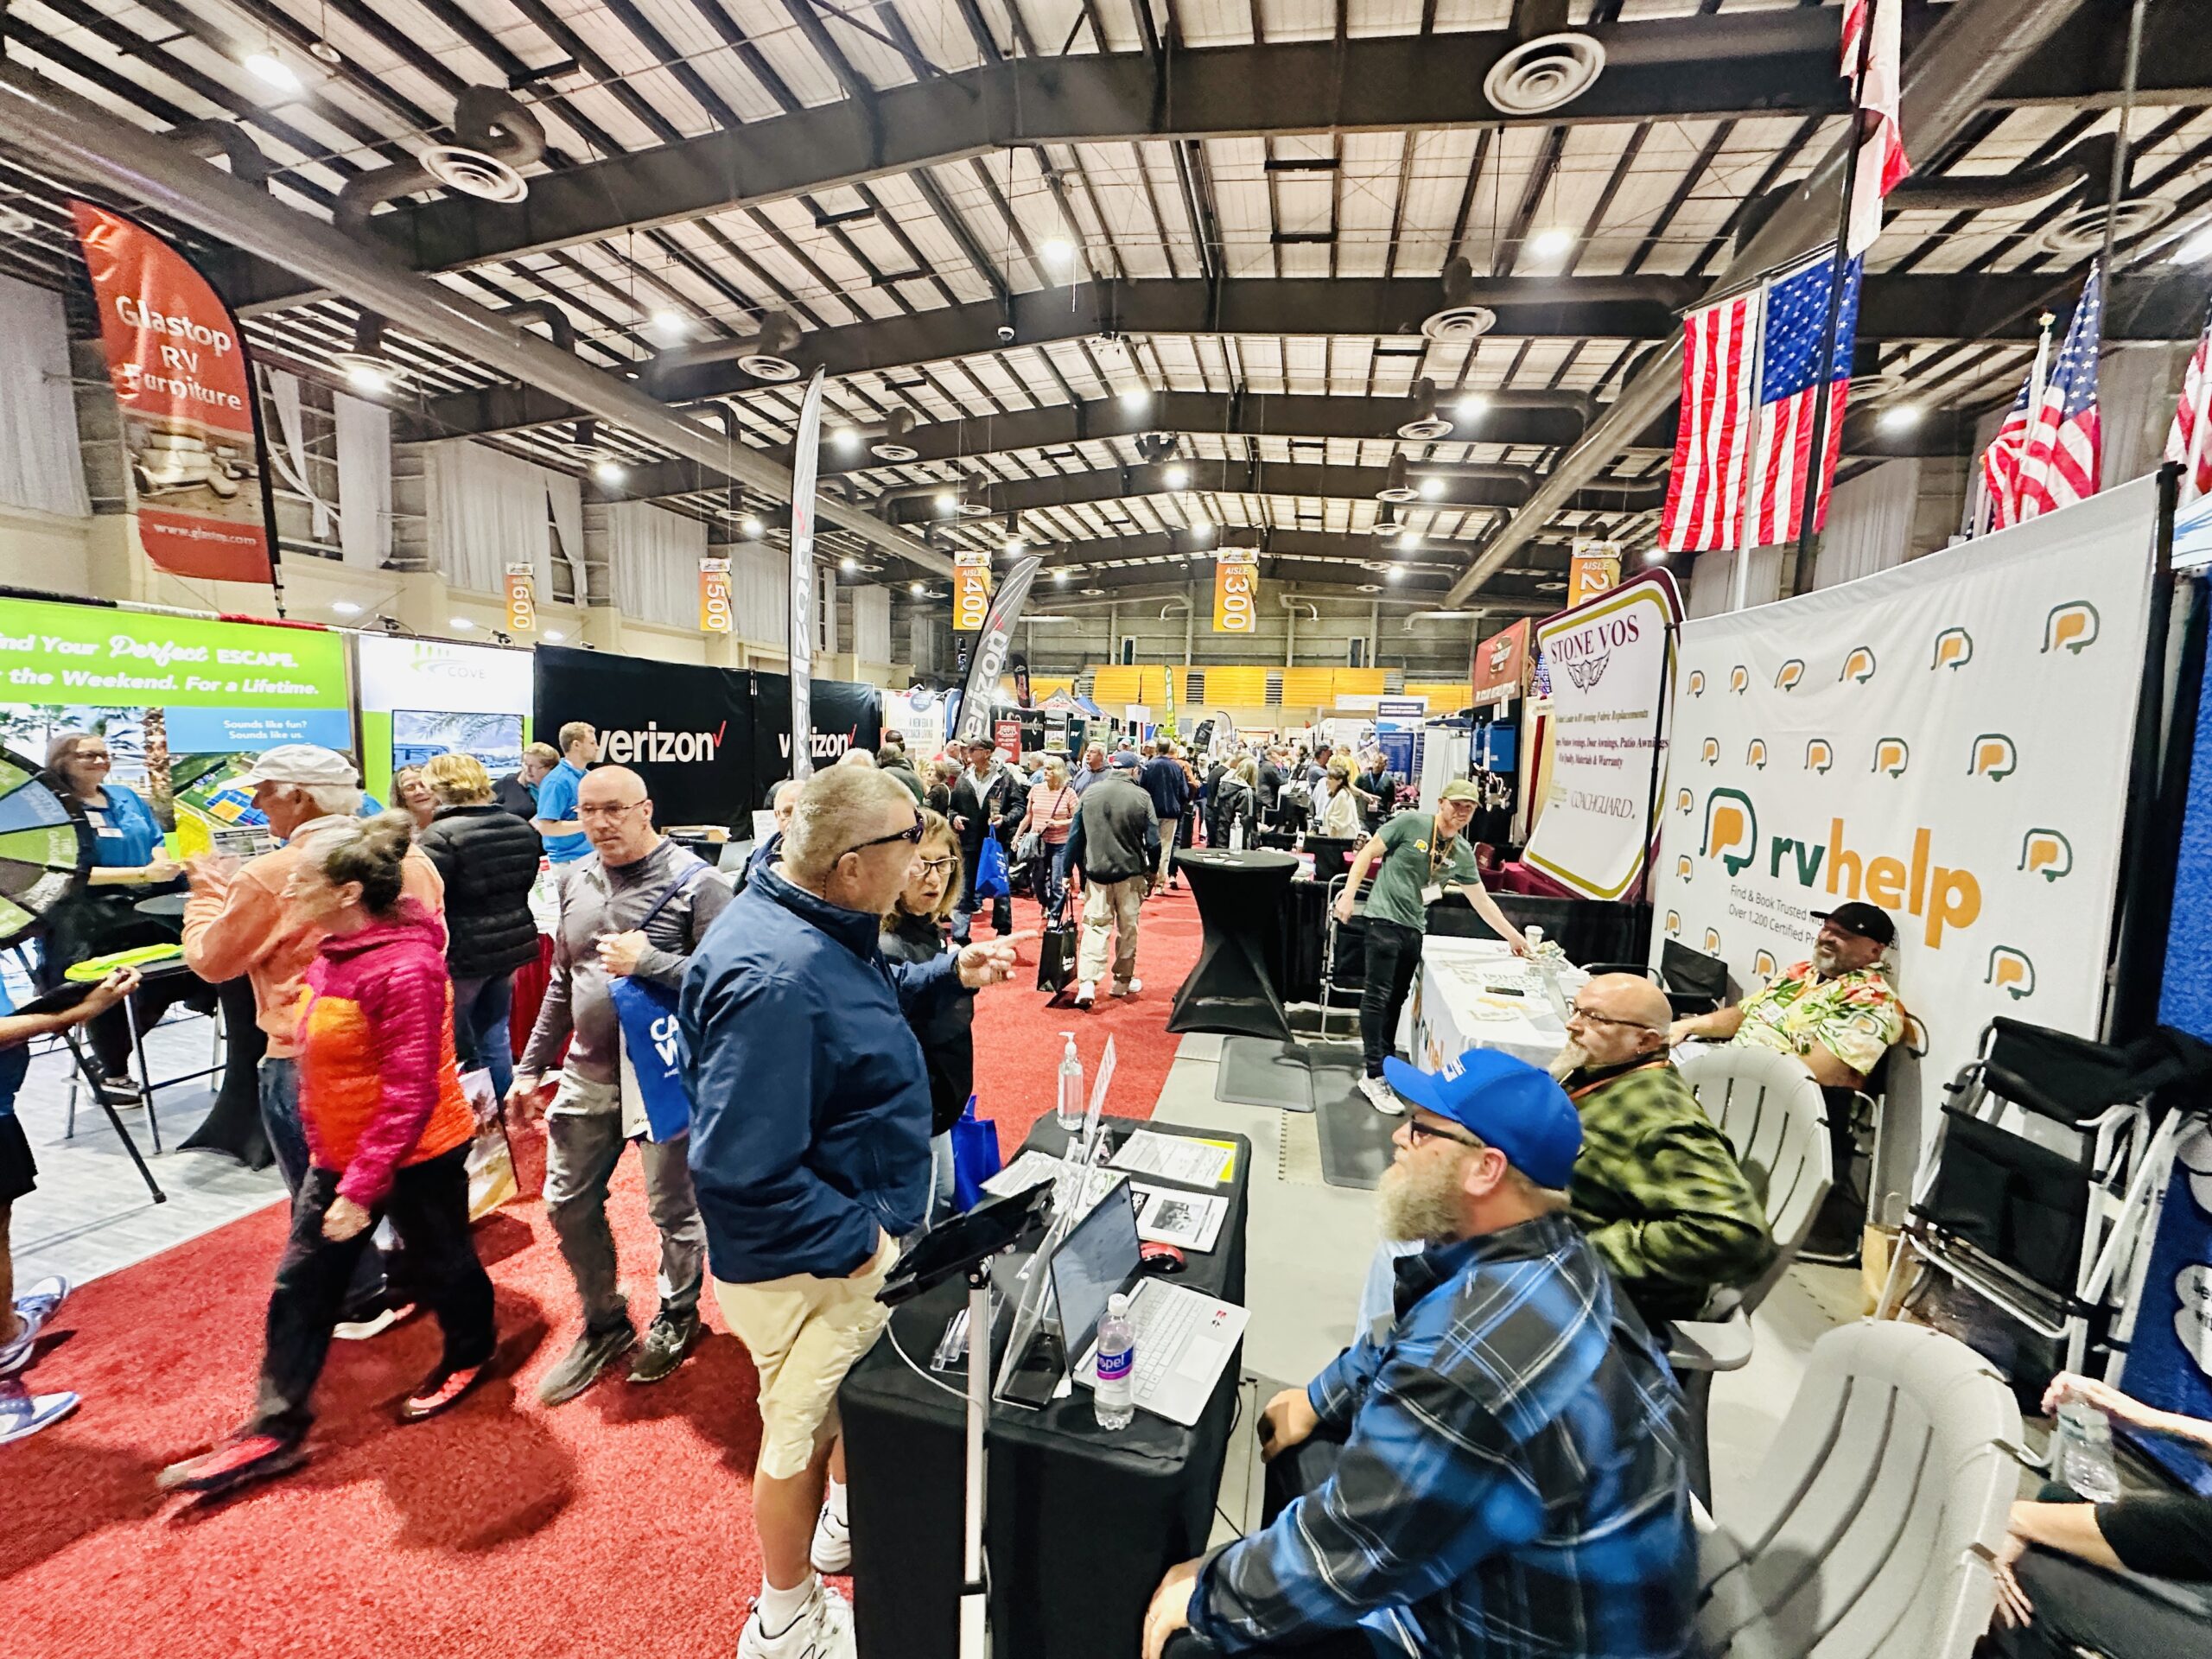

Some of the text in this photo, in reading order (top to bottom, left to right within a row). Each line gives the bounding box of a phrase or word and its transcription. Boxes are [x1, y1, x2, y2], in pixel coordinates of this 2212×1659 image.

[115, 295, 232, 358] Glastop
[160, 345, 200, 373] RV
[122, 362, 243, 410] Furniture
[962, 568, 983, 577] AISLE
[1224, 567, 1249, 575] AISLE
[1582, 562, 1611, 571] AISLE
[512, 586, 530, 629] 600
[707, 584, 727, 629] 500
[961, 577, 984, 628] 400
[1223, 576, 1249, 630] 300
[41, 635, 100, 655] Your
[109, 635, 209, 667] Perfect
[216, 648, 299, 668] ESCAPE.
[792, 537, 810, 774] verizon
[1550, 629, 1594, 664] STONE
[1598, 614, 1640, 650] VOS
[9, 667, 320, 696] the Weekend. For a Lifetime.
[448, 666, 486, 679] COVE
[964, 629, 1008, 740] erizon
[223, 720, 308, 729] Sounds like fun?
[228, 730, 270, 740] Sounds
[270, 730, 289, 740] like
[594, 721, 715, 764] verizon
[778, 727, 849, 759] vizon
[1599, 754, 1624, 769] Warranty
[1620, 737, 1636, 748] Patio
[1637, 737, 1669, 751] Awnigs
[1770, 817, 1982, 950] rvhelp
[1730, 885, 1747, 900] Find
[1748, 892, 1755, 903] &
[1756, 893, 1776, 911] Book
[1776, 899, 1808, 922] Trusted
[1728, 903, 1747, 920] Over
[1748, 910, 1769, 929] 1,200
[1770, 918, 1803, 944] Certified
